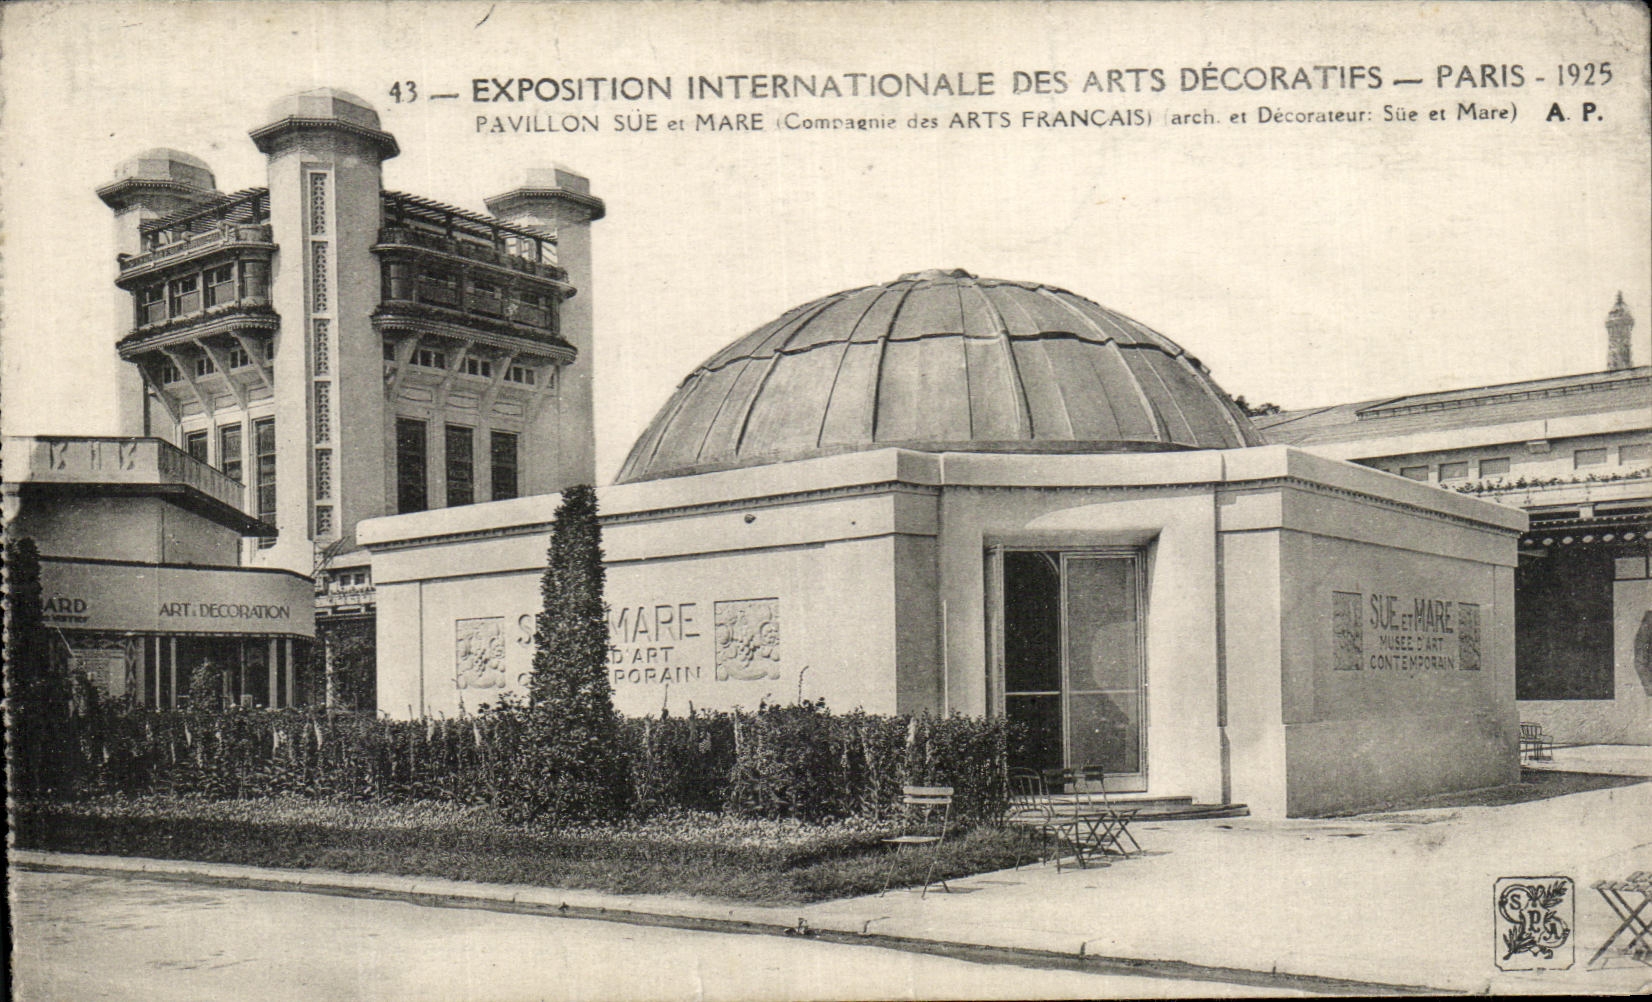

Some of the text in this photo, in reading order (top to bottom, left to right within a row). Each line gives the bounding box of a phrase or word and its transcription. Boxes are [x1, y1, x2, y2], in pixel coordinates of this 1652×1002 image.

[199, 603, 290, 619] DECORATION
[605, 603, 701, 644] MARE
[1402, 614, 1413, 631] ET
[1414, 598, 1454, 634] MARE
[1370, 654, 1455, 671] CONTEMPORAIN
